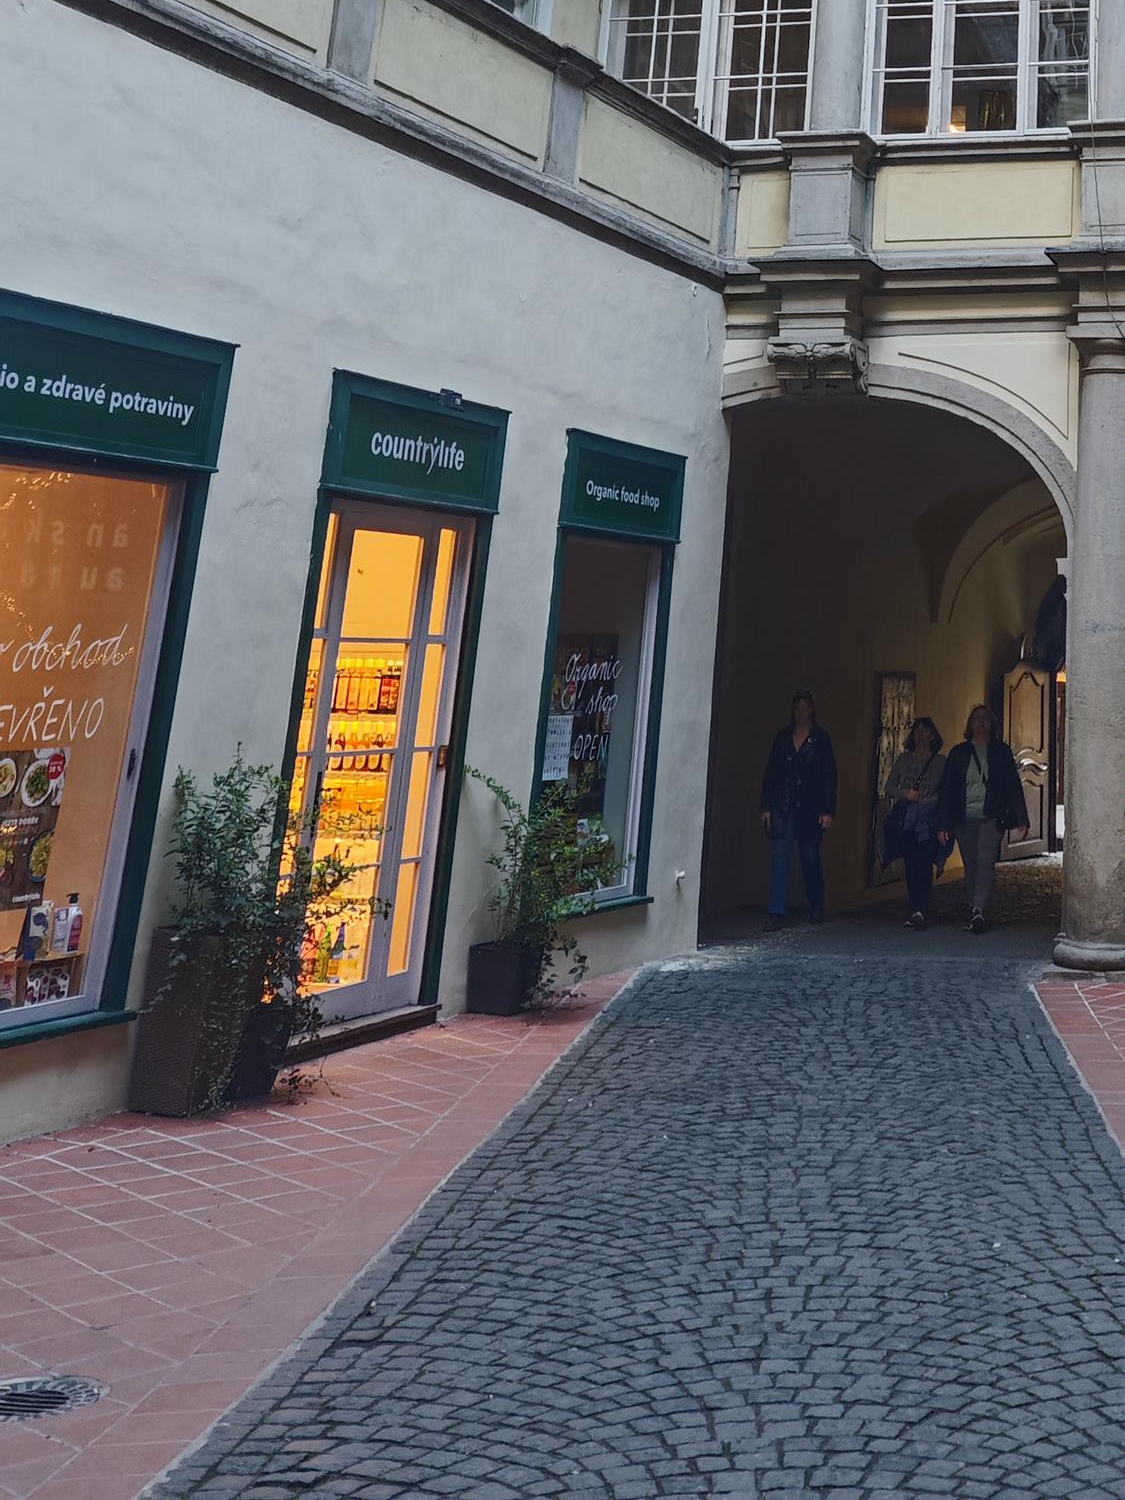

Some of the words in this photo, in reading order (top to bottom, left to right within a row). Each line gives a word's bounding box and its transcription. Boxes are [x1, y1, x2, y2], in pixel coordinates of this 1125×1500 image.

[0, 363, 19, 389] io
[24, 375, 35, 392] a
[40, 374, 105, 405] zdravé
[109, 391, 194, 426] potraviny
[586, 480, 620, 501] Organic
[620, 486, 640, 504] food
[641, 490, 660, 512] shop
[12, 624, 128, 672] obchod
[585, 686, 618, 725] shop
[573, 734, 609, 760] OPEN
